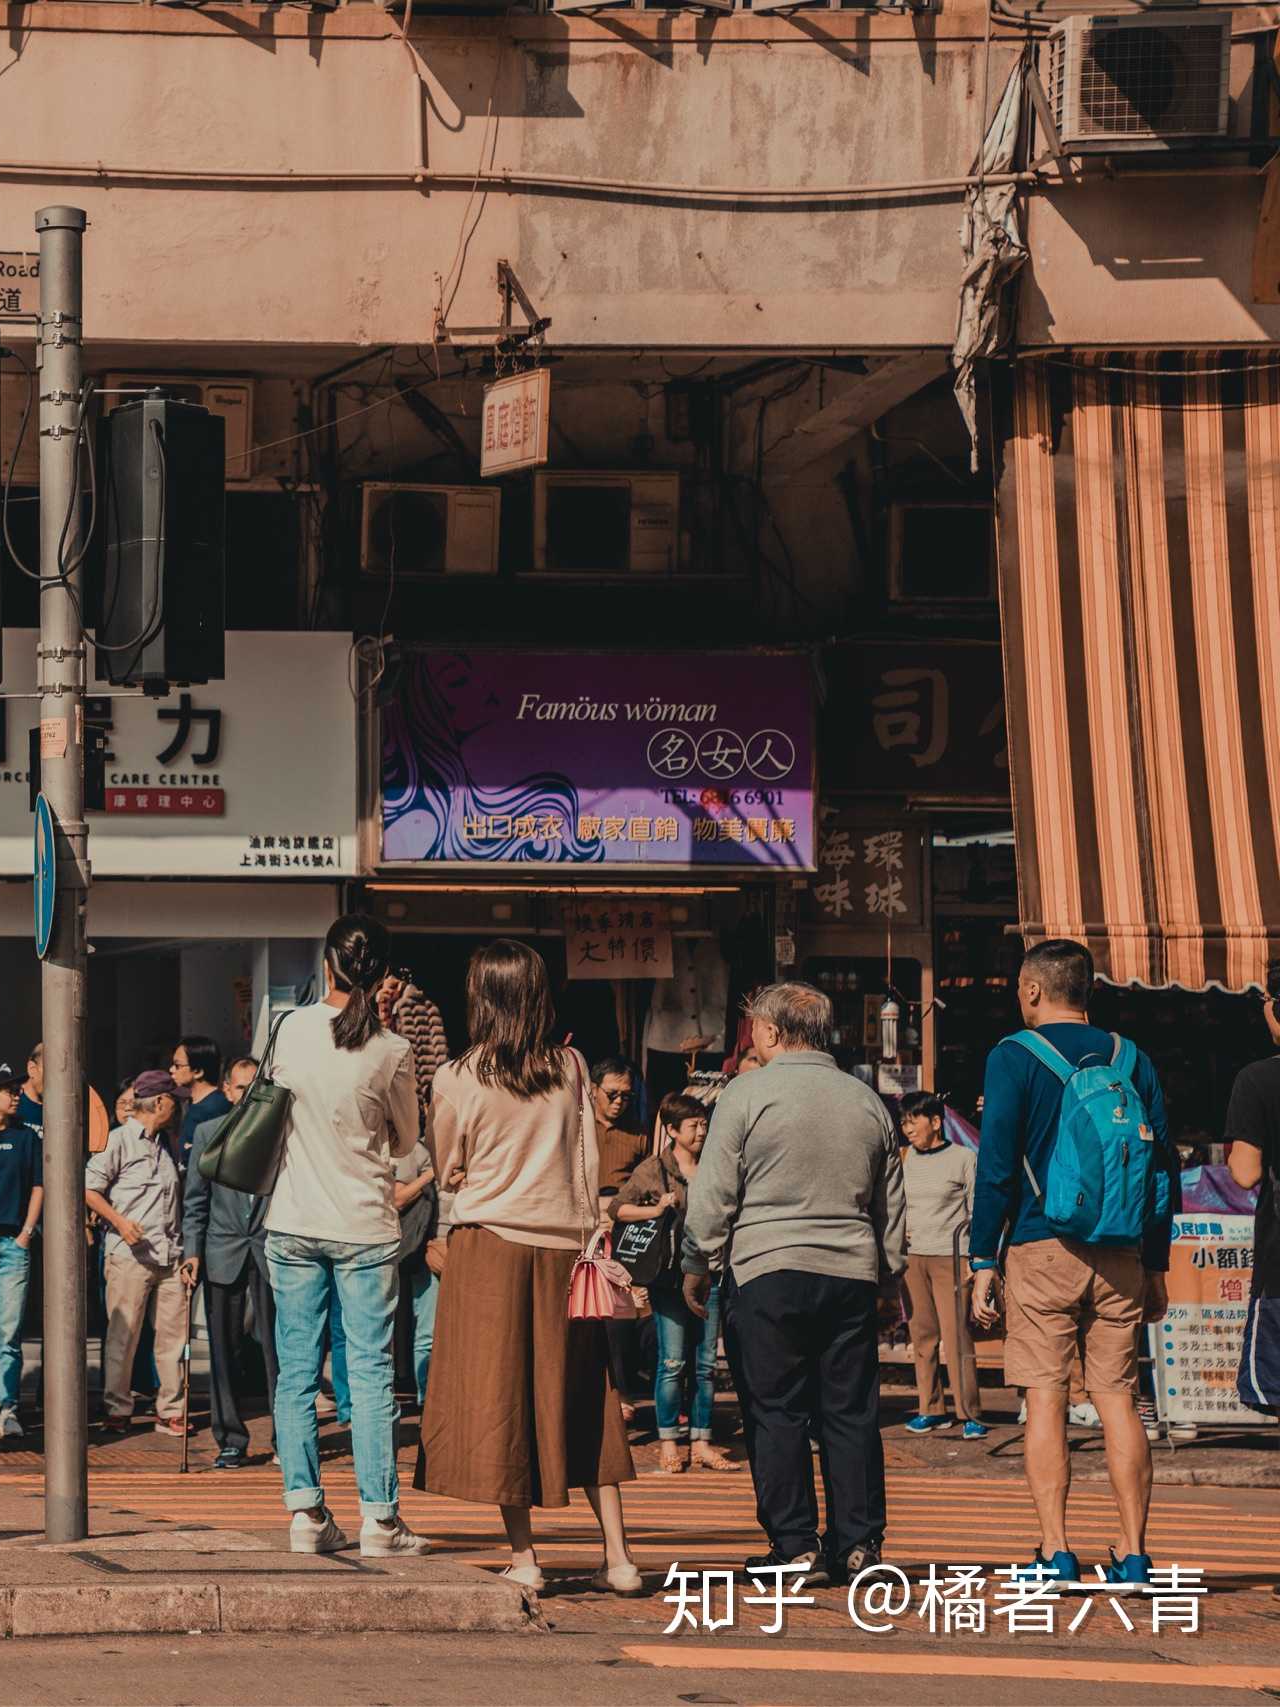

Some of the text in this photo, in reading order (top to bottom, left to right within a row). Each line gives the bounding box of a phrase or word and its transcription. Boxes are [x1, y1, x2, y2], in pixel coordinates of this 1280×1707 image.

[516, 694, 718, 722] Famöus wöman
[651, 732, 792, 775] 名女人
[111, 773, 150, 785] CARE
[159, 774, 220, 786] CENTRE
[661, 788, 697, 805] TEL:
[745, 789, 785, 806] 6901
[464, 815, 796, 843] 出口成衣 廠家直銷 物美價廉
